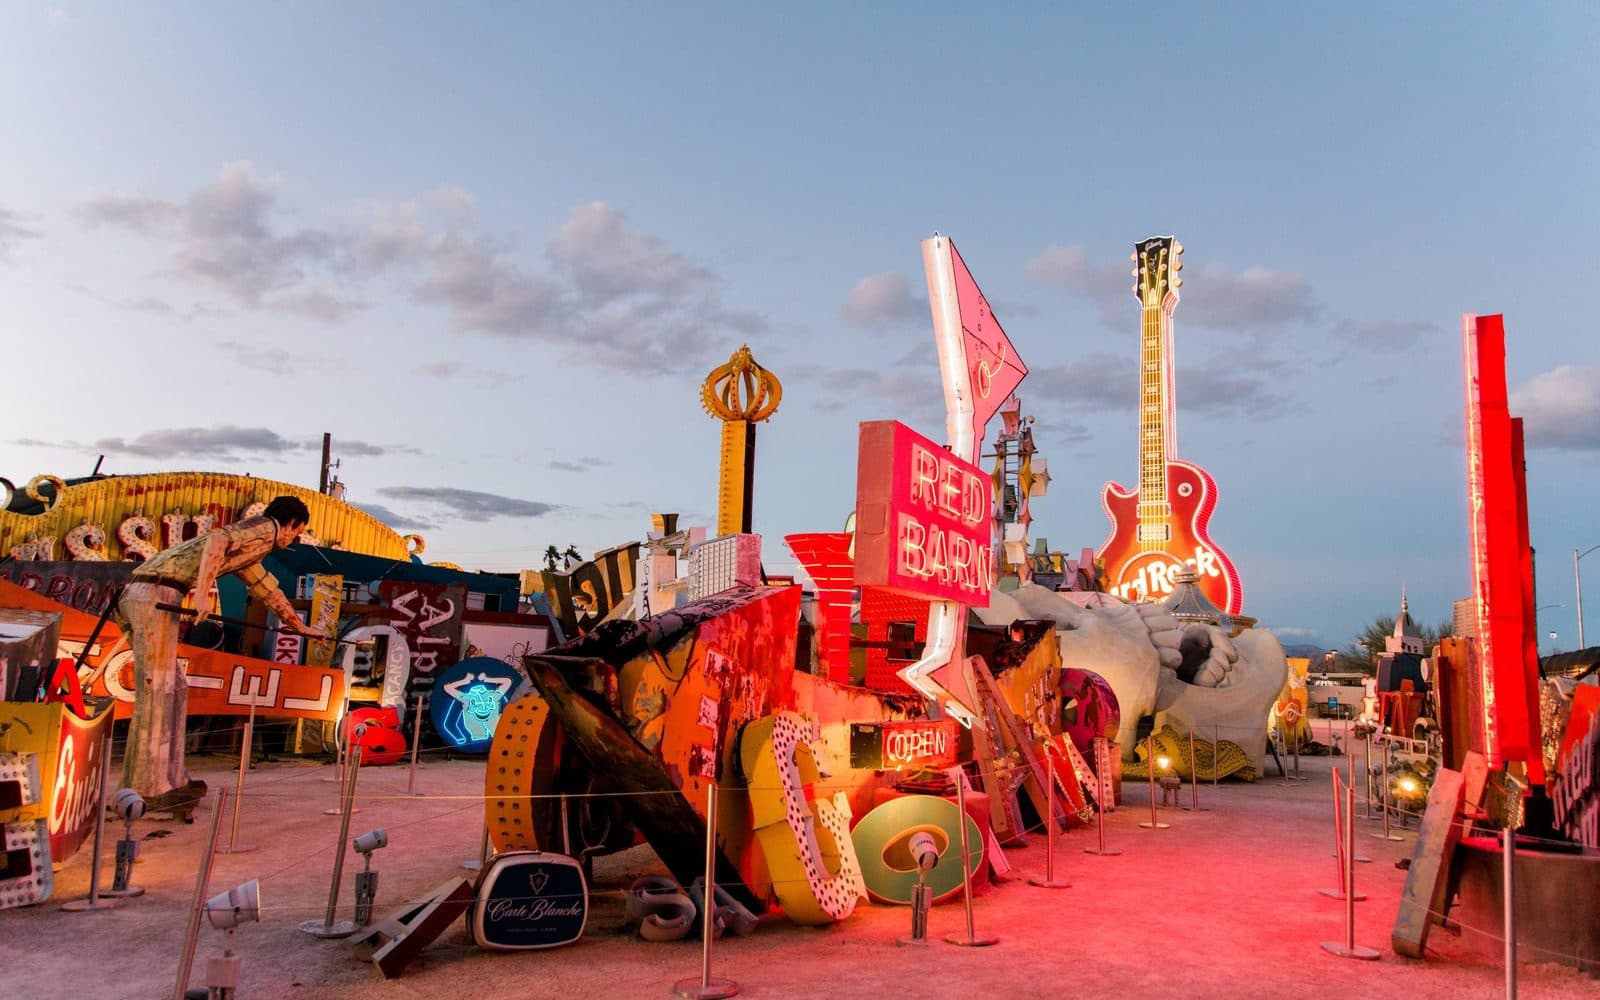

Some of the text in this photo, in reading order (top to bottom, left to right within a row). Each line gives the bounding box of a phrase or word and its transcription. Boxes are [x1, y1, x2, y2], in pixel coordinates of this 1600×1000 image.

[911, 443, 985, 528] RED
[897, 512, 993, 596] BARN
[387, 643, 403, 706] ACANCY
[886, 729, 947, 762] OPEN
[488, 899, 582, 922] Carte Blanche
